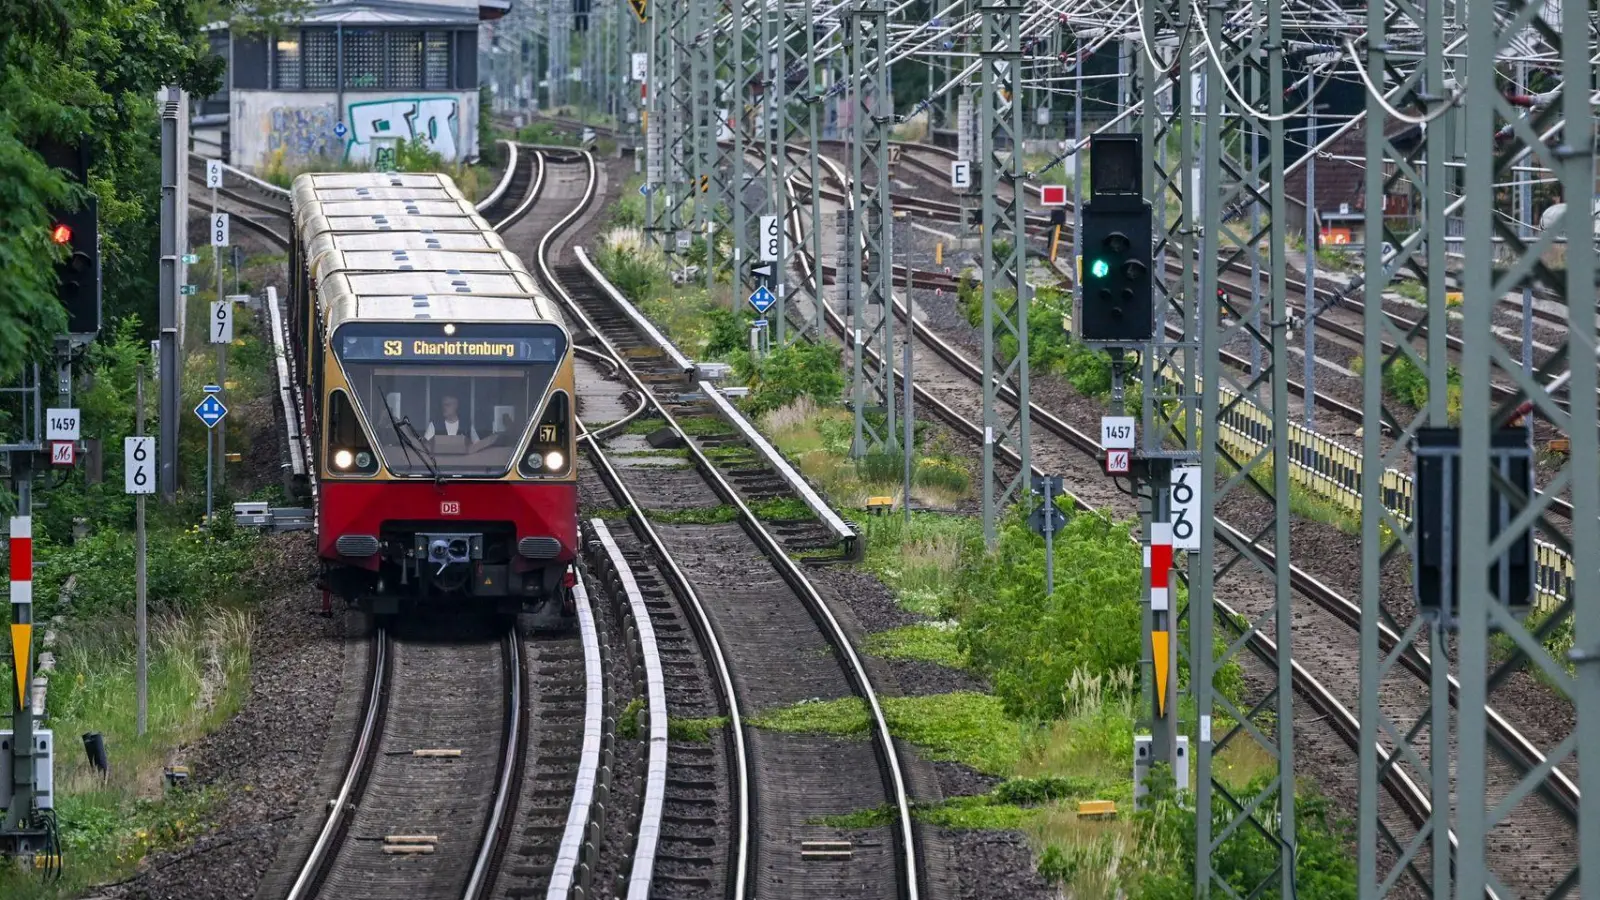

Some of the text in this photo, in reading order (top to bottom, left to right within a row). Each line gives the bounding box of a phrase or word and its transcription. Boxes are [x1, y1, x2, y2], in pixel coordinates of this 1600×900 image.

[211, 164, 218, 174] 6
[955, 164, 966, 184] E
[211, 175, 218, 185] 9
[215, 215, 224, 228] 6
[768, 218, 778, 236] 6
[215, 229, 224, 242] 8
[768, 238, 778, 256] 8
[216, 304, 226, 320] 6
[216, 322, 225, 337] 7
[383, 340, 514, 357] S3 Charlottenburg
[51, 418, 75, 431] 1459
[540, 426, 555, 441] 57
[1105, 426, 1131, 439] 1457
[133, 440, 147, 461] 6
[133, 465, 147, 486] 6
[1172, 472, 1194, 504] 6
[442, 503, 459, 513] DB
[1172, 508, 1194, 540] 6
